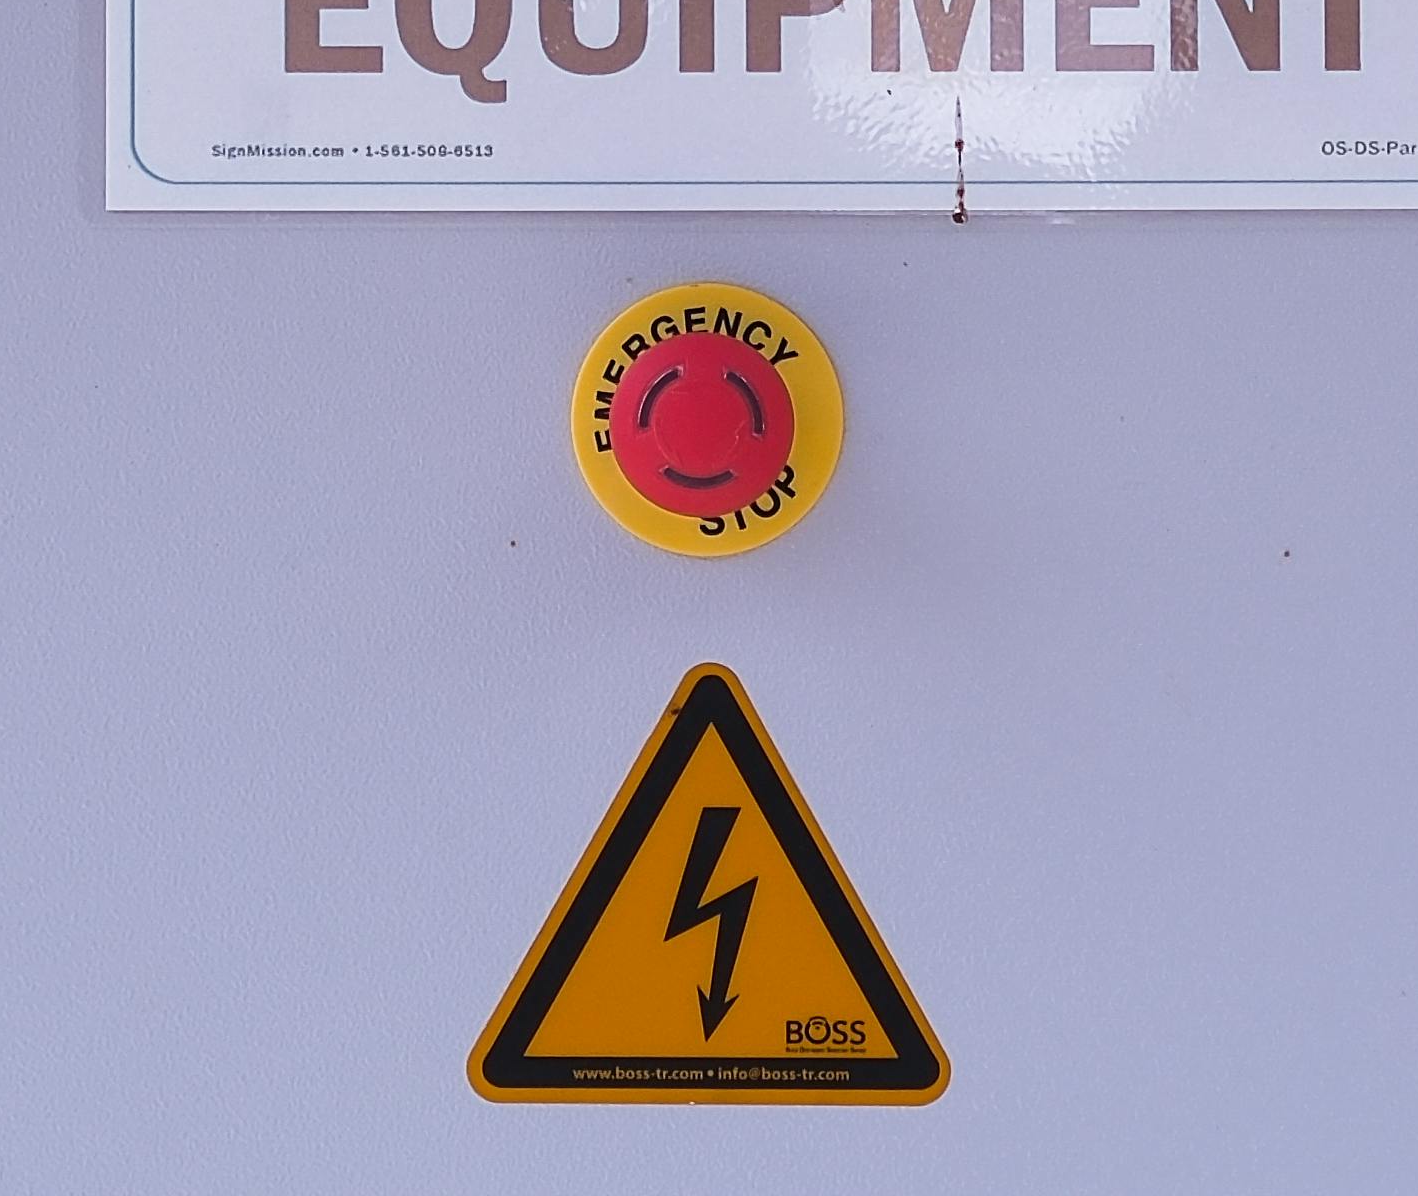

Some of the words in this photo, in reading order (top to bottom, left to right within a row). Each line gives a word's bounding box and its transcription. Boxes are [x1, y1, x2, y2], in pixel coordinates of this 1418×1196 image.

[211, 143, 345, 159] SignMission.com
[593, 306, 799, 453] EMERGENCY
[786, 1016, 866, 1045] BOSS
[572, 1066, 704, 1081] www.boss-tr.com
[718, 1067, 851, 1082] info@boss-tr.com
